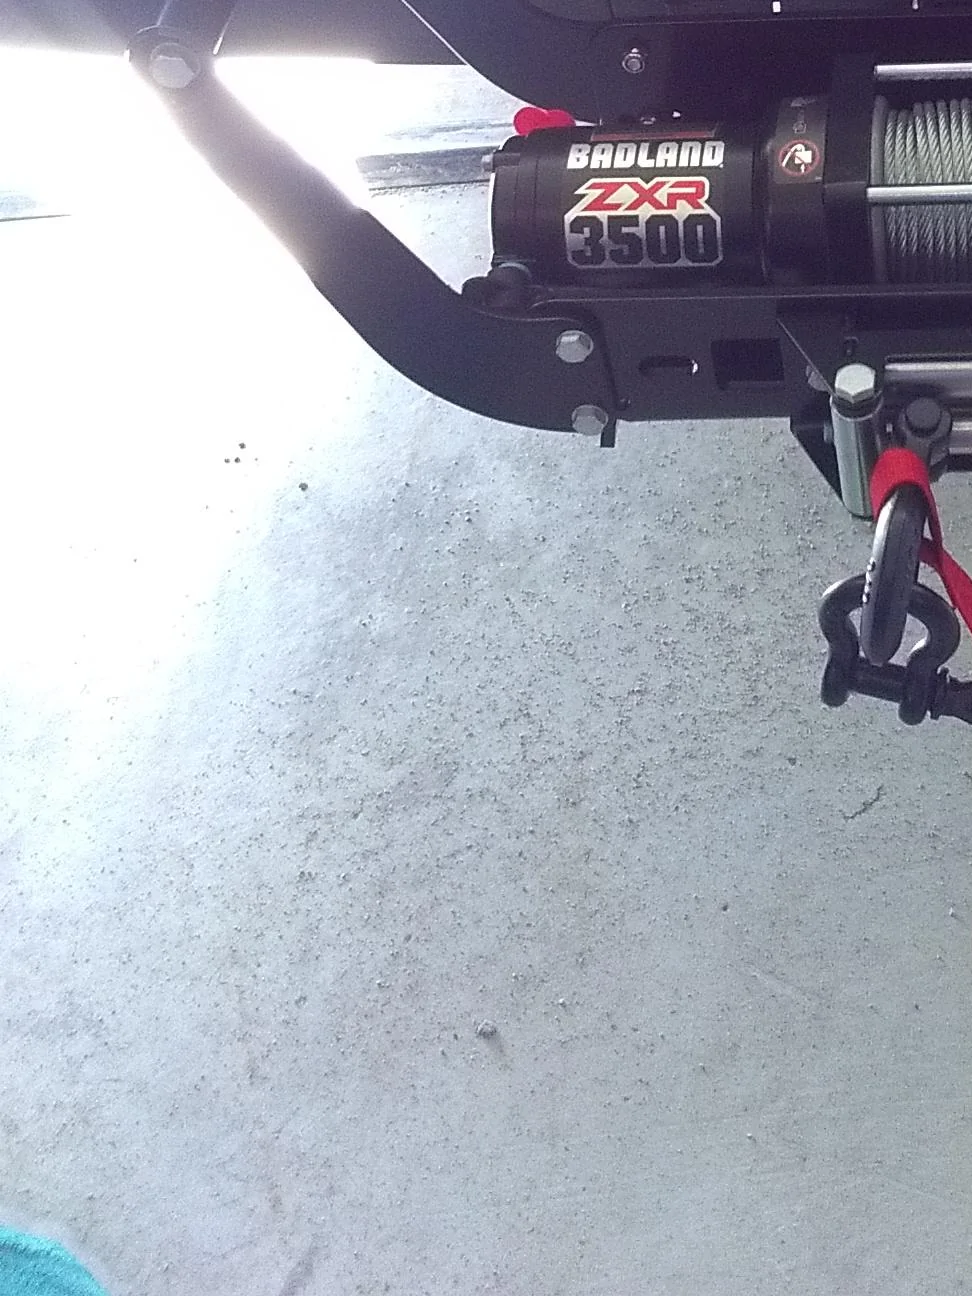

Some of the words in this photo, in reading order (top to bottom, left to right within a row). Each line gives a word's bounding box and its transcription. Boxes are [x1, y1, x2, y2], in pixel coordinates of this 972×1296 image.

[567, 141, 725, 169] BADLAND
[574, 176, 710, 212] ZXR
[565, 214, 723, 268] 3500
